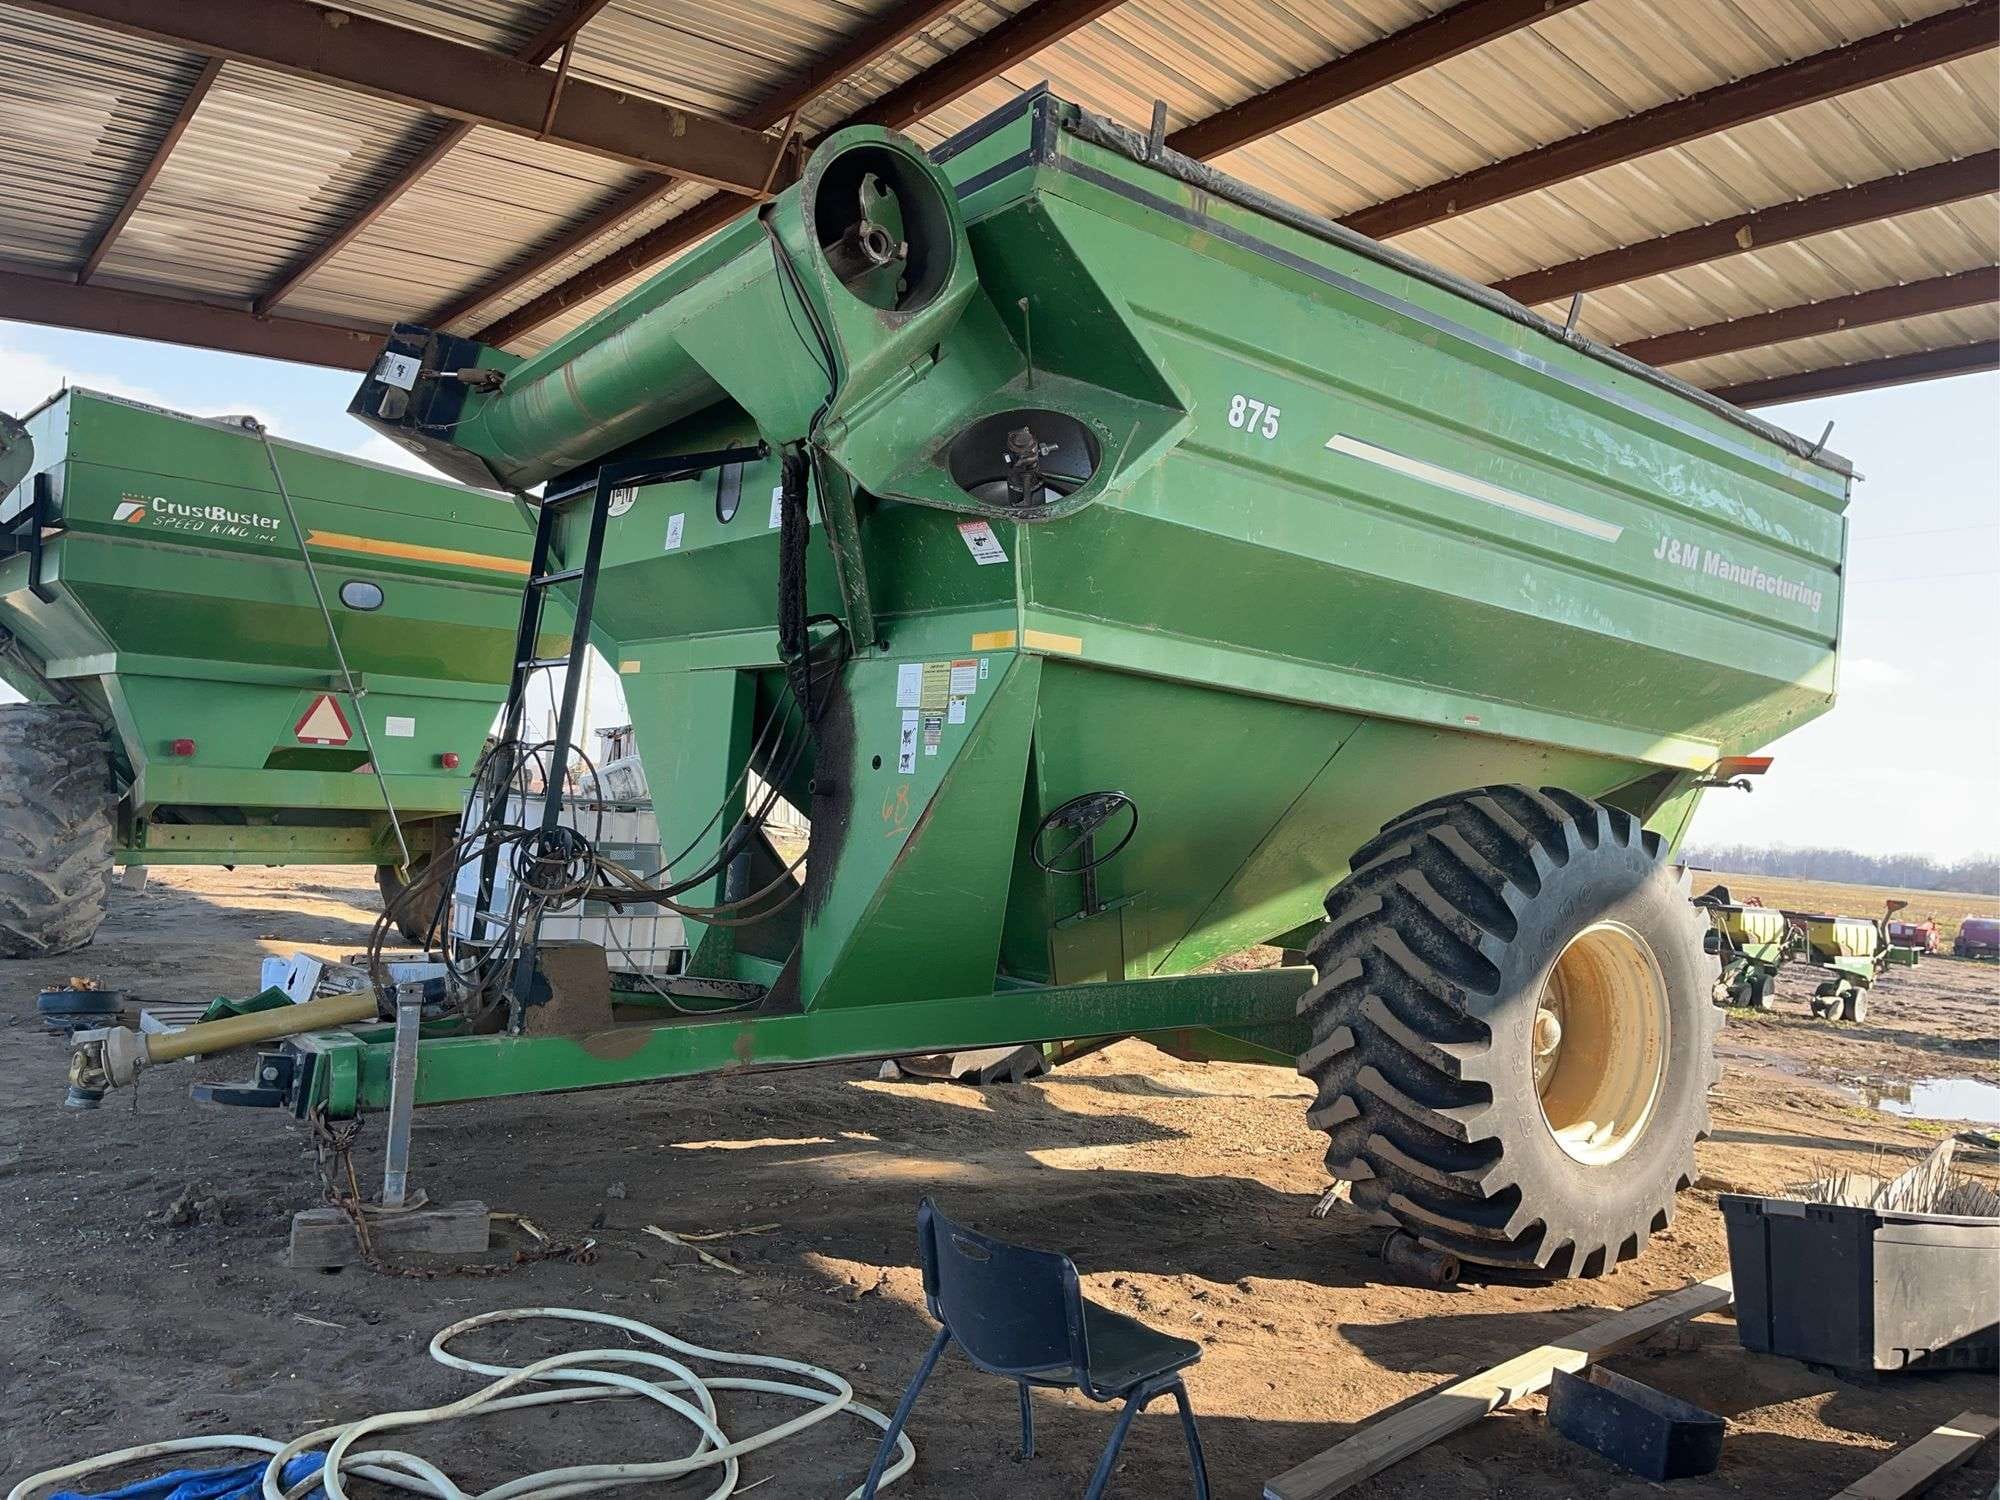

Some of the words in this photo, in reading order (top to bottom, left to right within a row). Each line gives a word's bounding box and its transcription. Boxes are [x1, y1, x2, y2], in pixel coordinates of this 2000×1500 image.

[1229, 394, 1281, 439] 875
[152, 497, 281, 529] CrustBuster
[152, 515, 204, 531] SPEED
[1653, 535, 1700, 571] J&M
[1702, 549, 1822, 613] Manufacturing
